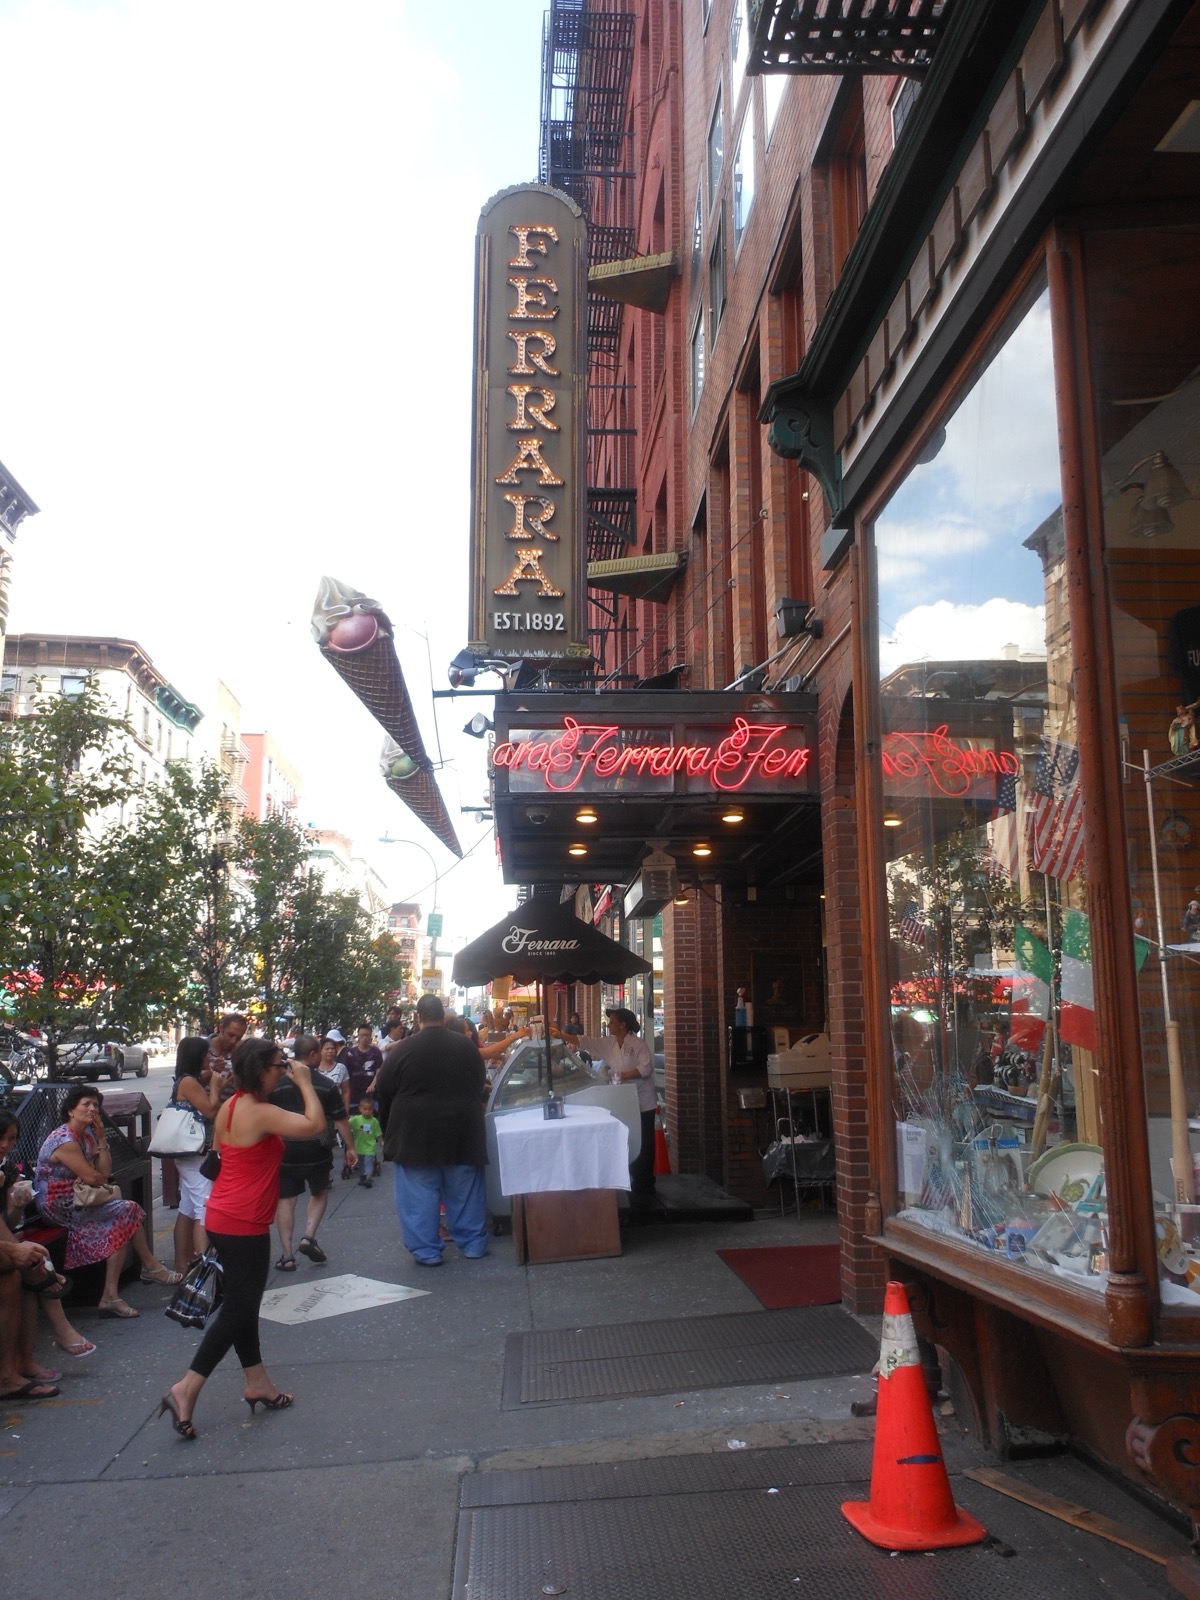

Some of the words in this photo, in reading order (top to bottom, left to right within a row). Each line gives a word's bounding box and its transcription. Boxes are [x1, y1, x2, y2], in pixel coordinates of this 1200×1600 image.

[494, 225, 564, 598] FERRARA
[1187, 649, 1200, 667] FU
[501, 925, 580, 954] Ferrara
